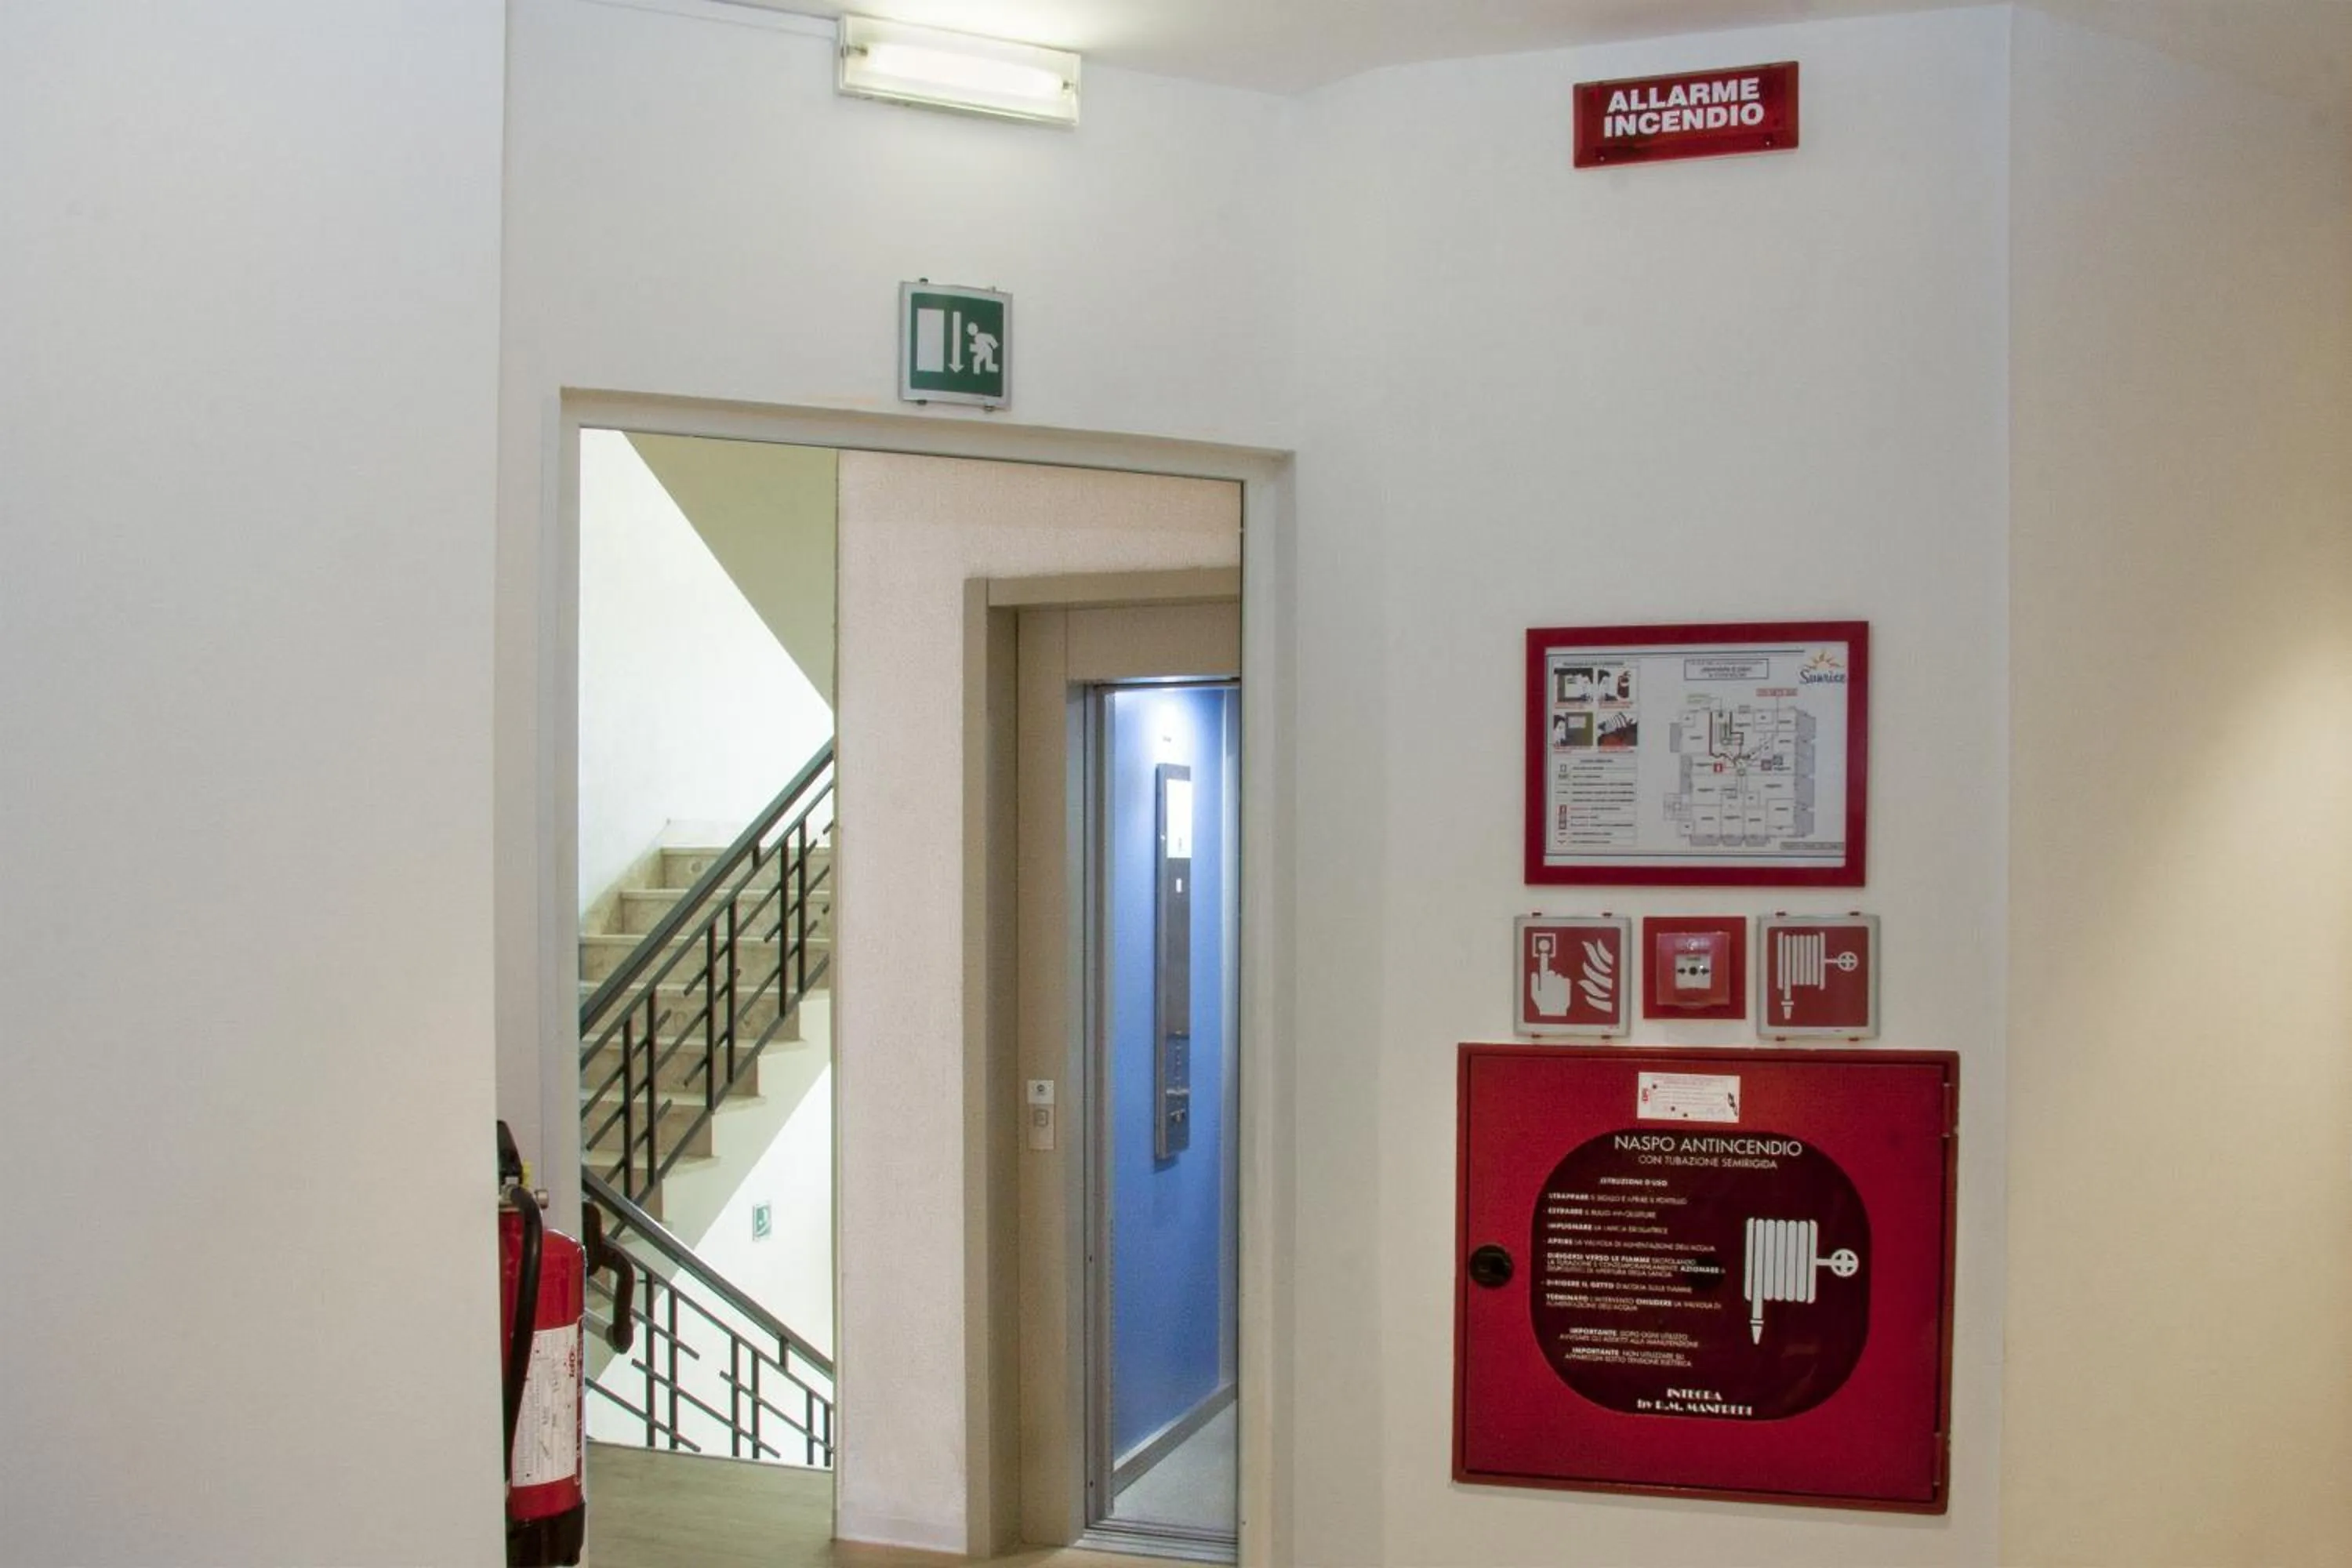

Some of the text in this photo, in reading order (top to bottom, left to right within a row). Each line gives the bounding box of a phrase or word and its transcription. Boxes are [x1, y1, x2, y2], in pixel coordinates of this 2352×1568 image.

[1607, 77, 1759, 113] ALLARME
[1604, 102, 1765, 138] INCENDIO
[1614, 1135, 1802, 1156] NASPO ANTINCENDIO
[1638, 1156, 1778, 1170] CON TUBAZIONE SEMIRIGIDA
[1666, 1388, 1722, 1401] INTEGRA
[1686, 1402, 1752, 1416] MANFREDI
